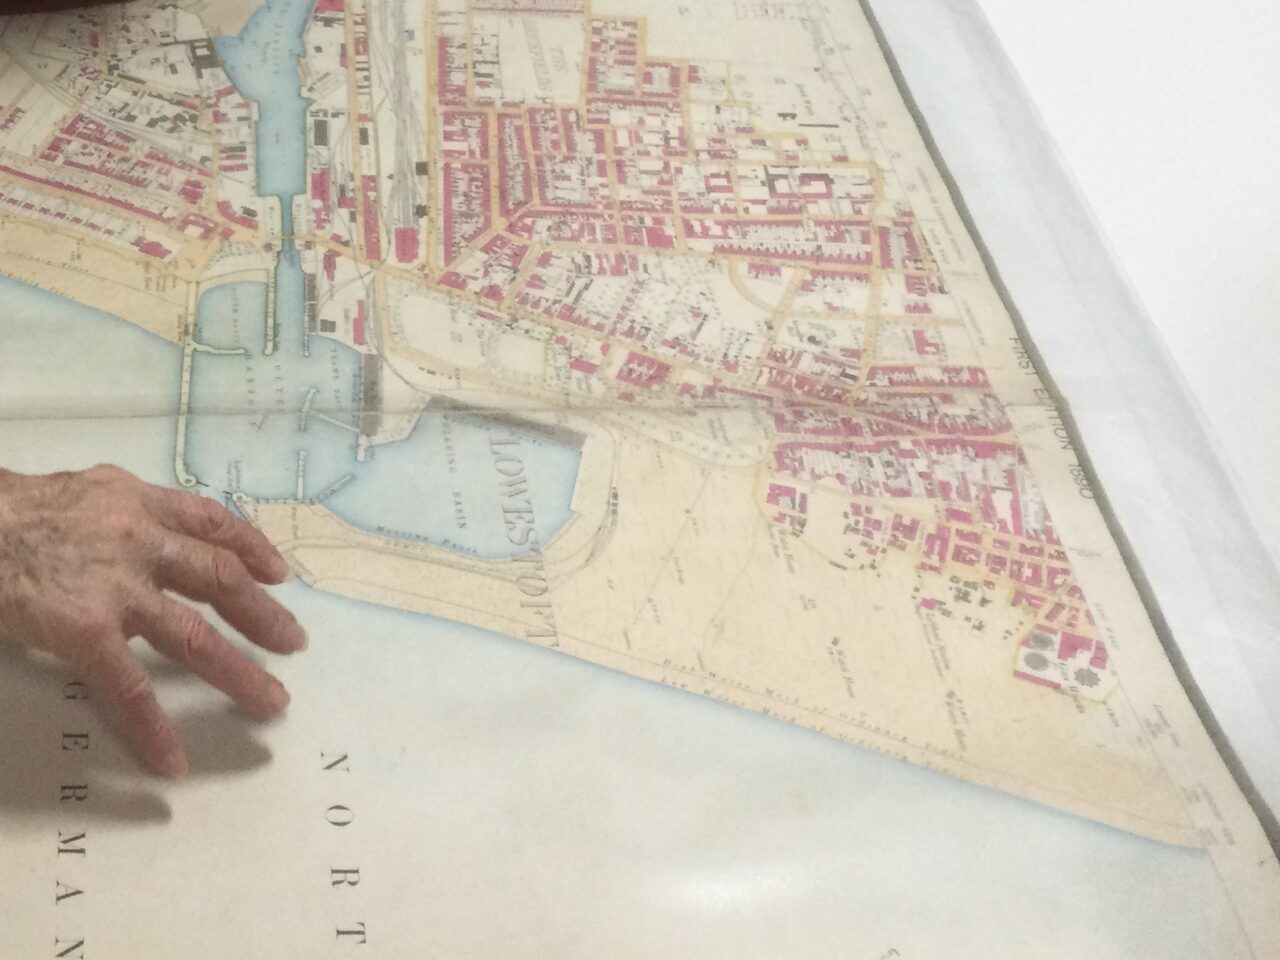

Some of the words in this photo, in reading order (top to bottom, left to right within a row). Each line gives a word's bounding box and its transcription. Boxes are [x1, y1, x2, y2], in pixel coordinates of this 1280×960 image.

[1009, 337, 1038, 376] FIRST
[1068, 463, 1095, 500] 1890
[489, 433, 560, 648] LOWESTOFT
[55, 680, 90, 960] GERMAN
